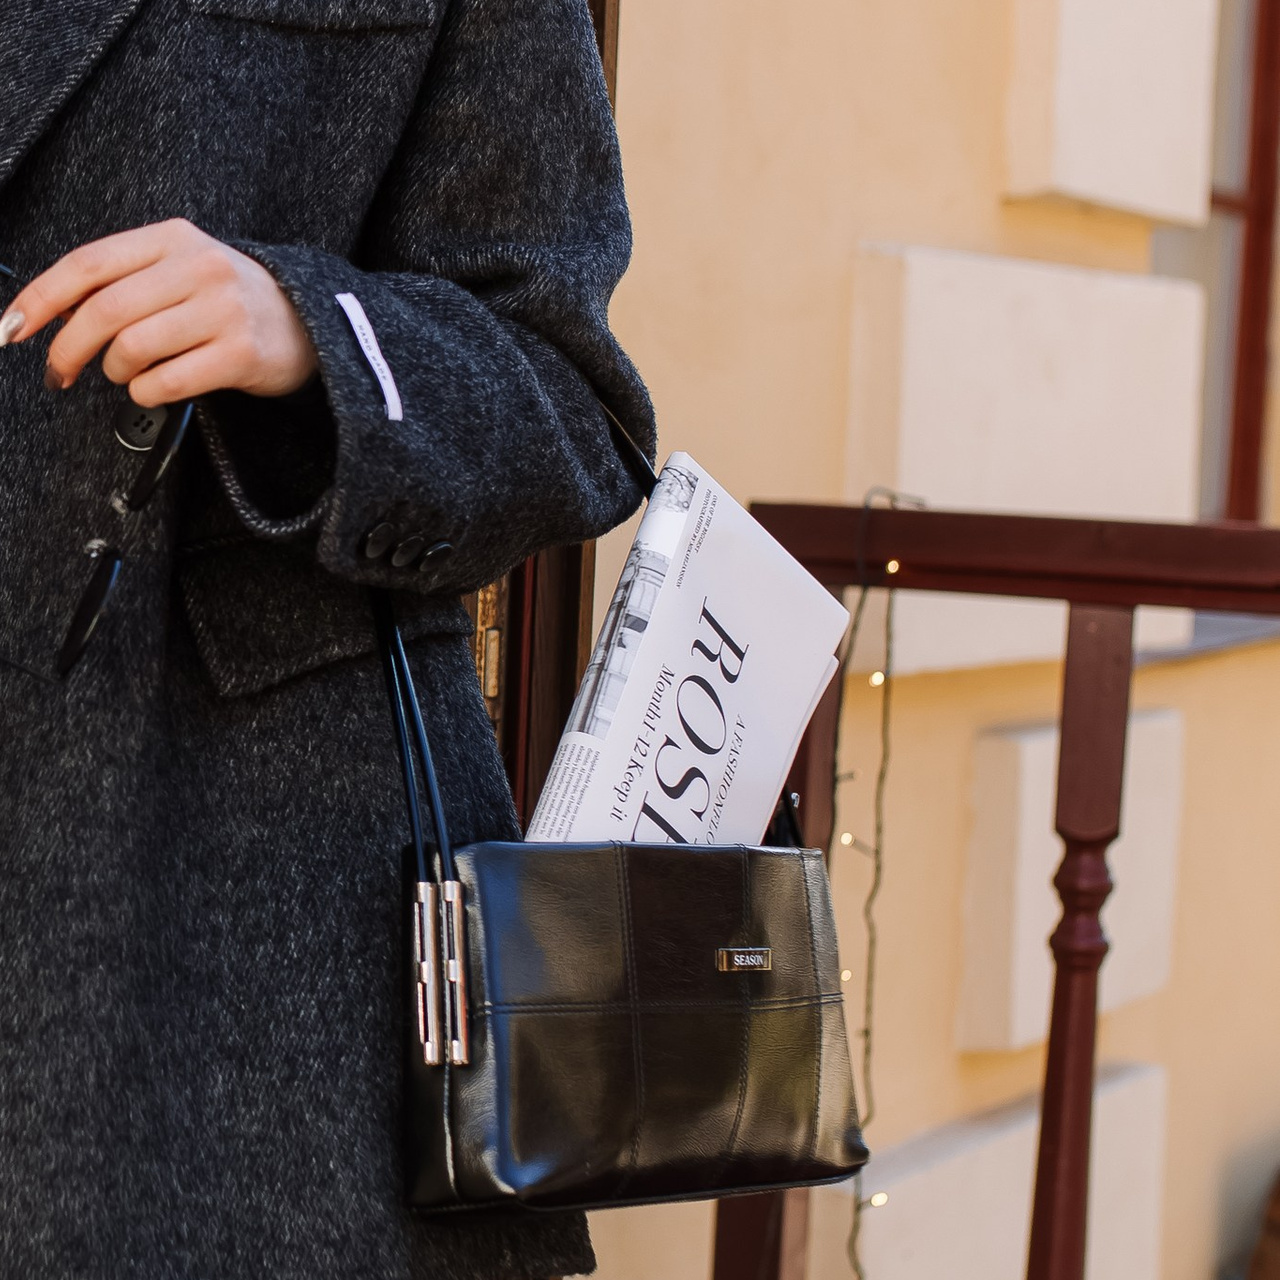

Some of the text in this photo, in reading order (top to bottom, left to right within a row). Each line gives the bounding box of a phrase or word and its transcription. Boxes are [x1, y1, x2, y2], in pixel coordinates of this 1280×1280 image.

[695, 527, 708, 553] BIGGEST
[731, 713, 747, 731] A
[613, 760, 645, 804] Keep
[610, 806, 628, 822] it
[733, 954, 764, 966] SEASON
